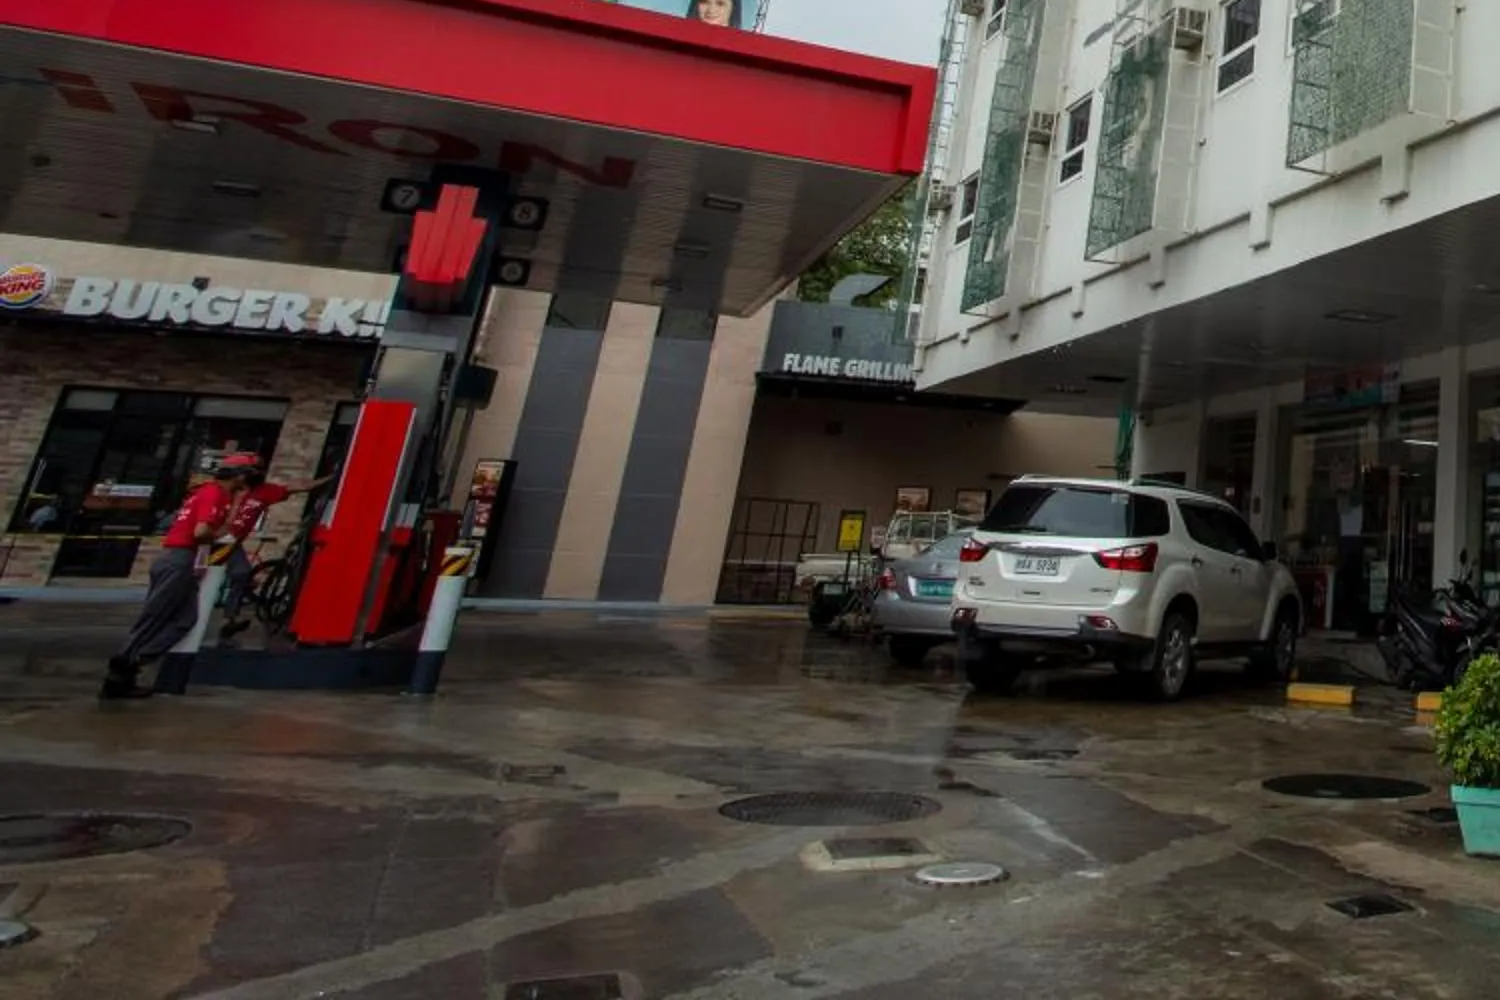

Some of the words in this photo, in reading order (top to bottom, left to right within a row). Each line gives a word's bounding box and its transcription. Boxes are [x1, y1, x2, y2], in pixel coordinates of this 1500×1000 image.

[402, 188, 414, 206] 7
[62, 277, 310, 333] BURGER
[319, 297, 390, 337] KI
[783, 353, 841, 376] FLAME
[843, 359, 918, 383] GRILLIN
